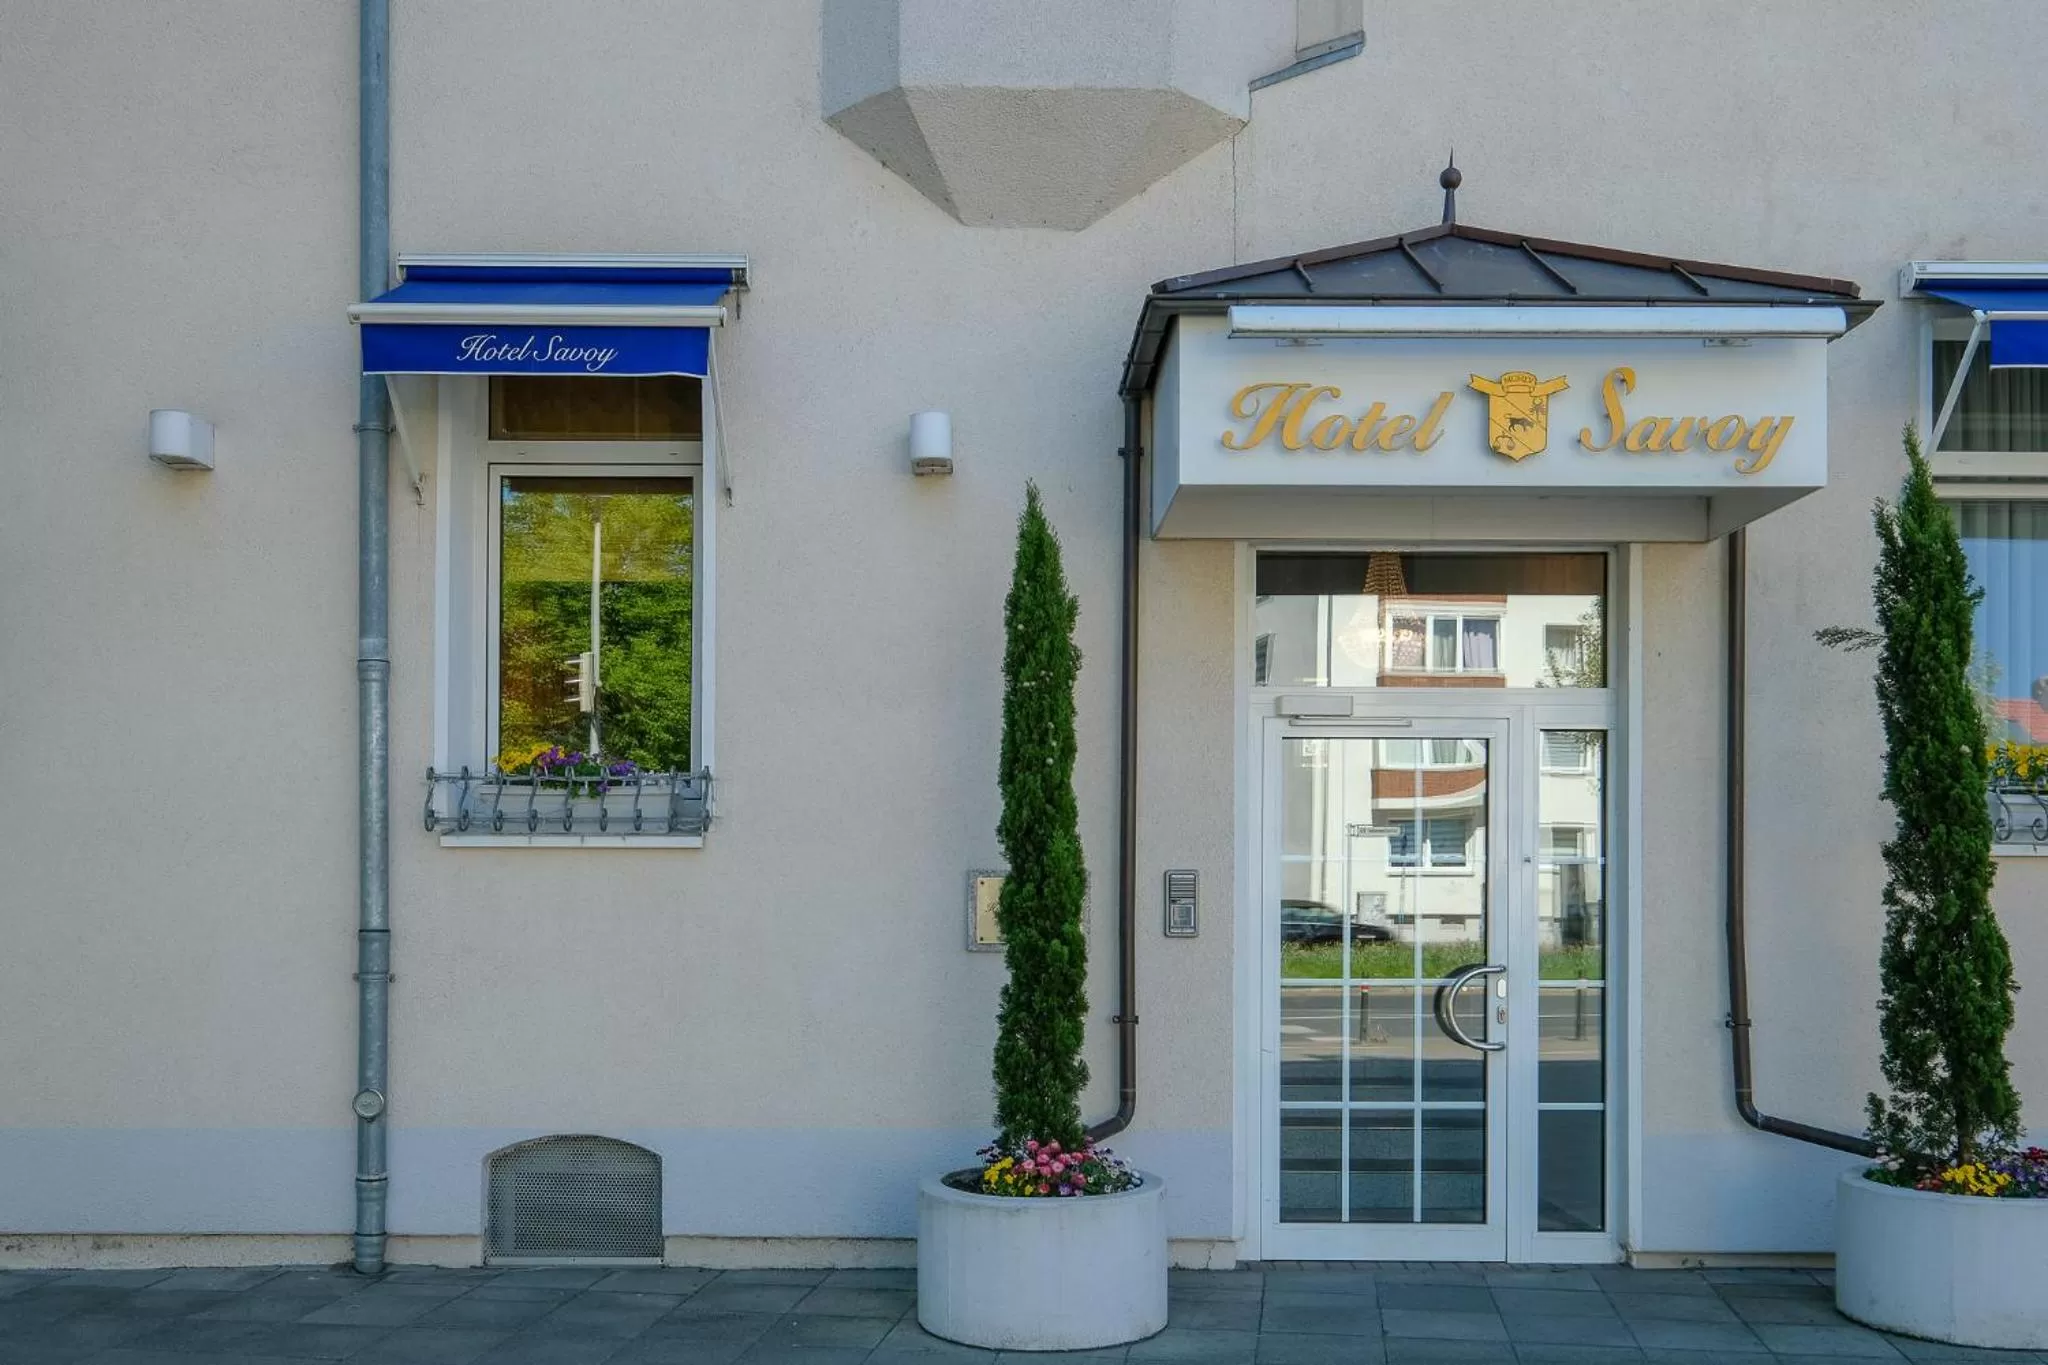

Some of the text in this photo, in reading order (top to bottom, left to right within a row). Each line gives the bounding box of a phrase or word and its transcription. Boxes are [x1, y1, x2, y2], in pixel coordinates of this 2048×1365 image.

[457, 334, 618, 372] Hotel Savoy
[1222, 366, 1795, 474] Hotel Savoy
